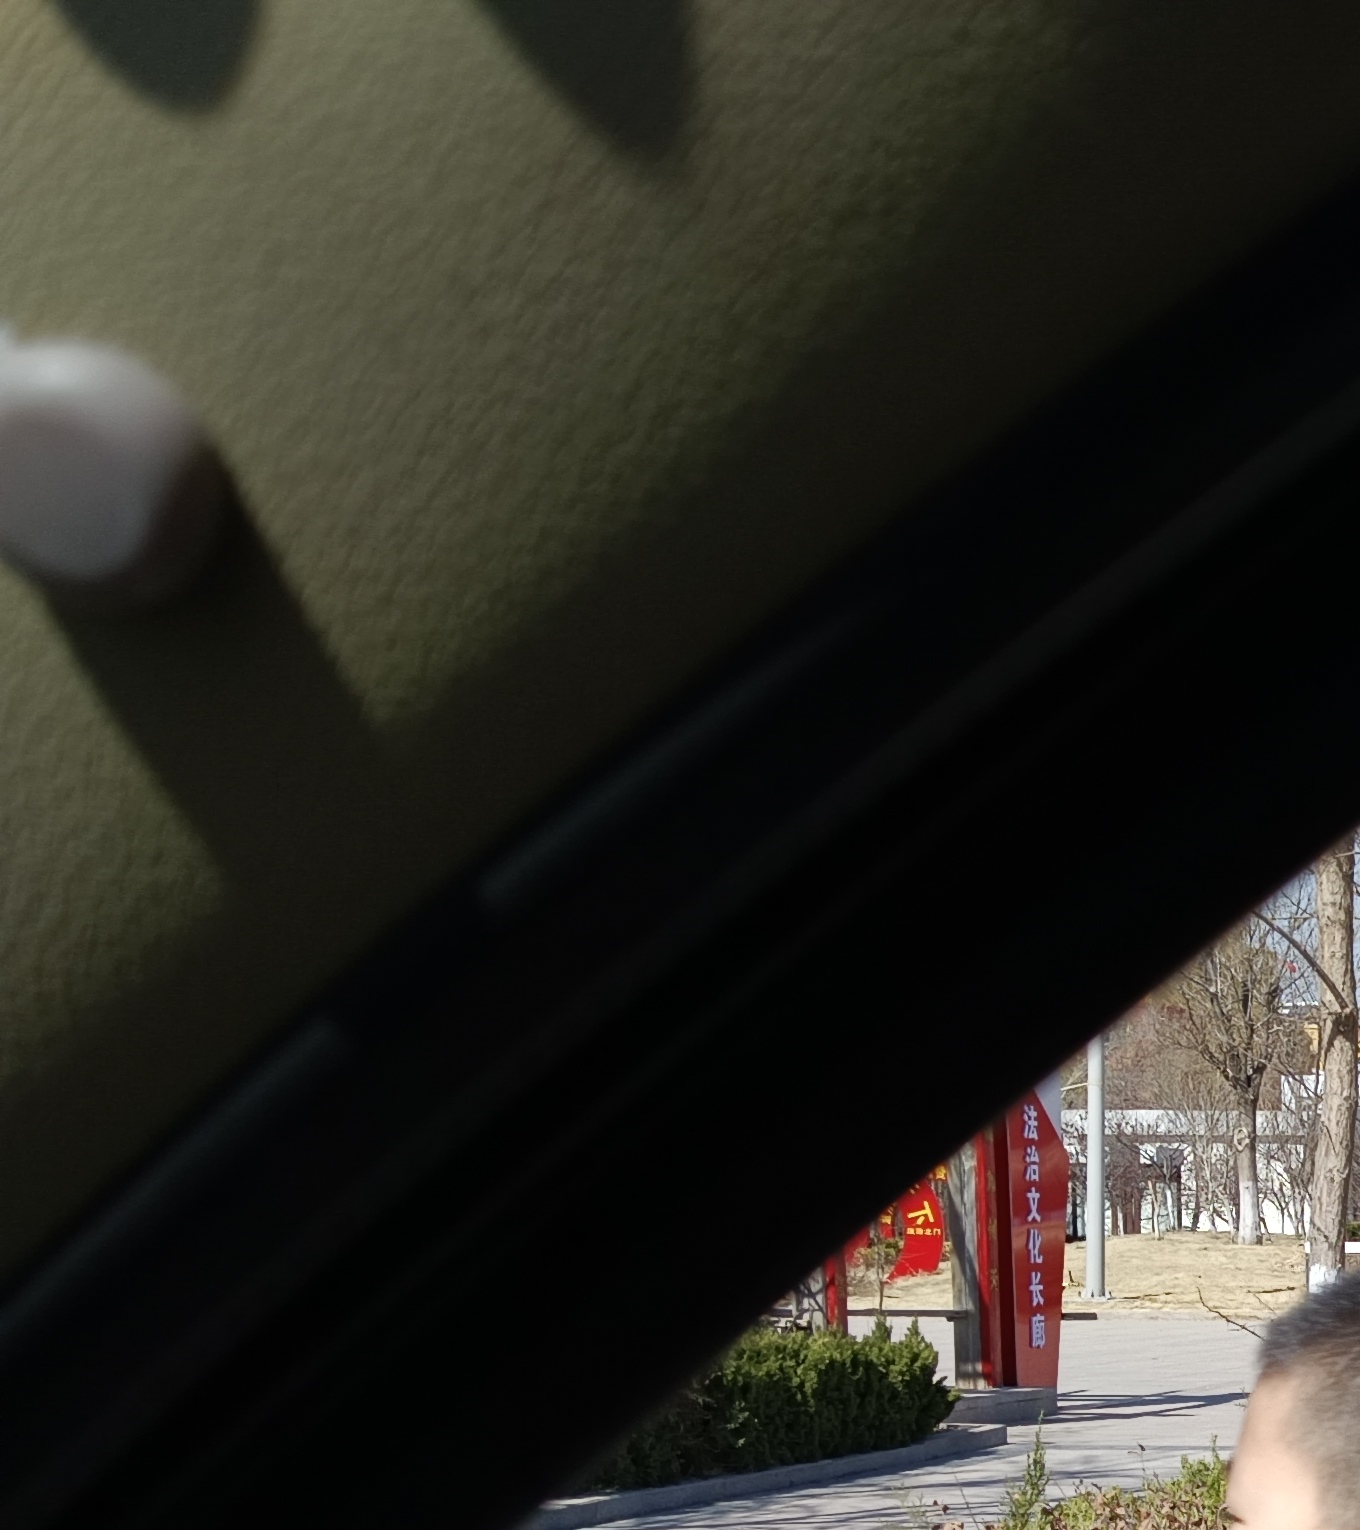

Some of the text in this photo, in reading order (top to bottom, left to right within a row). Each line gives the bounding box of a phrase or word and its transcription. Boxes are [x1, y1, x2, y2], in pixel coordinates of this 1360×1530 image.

[1022, 1104, 1046, 1349] 法治文化长廊
